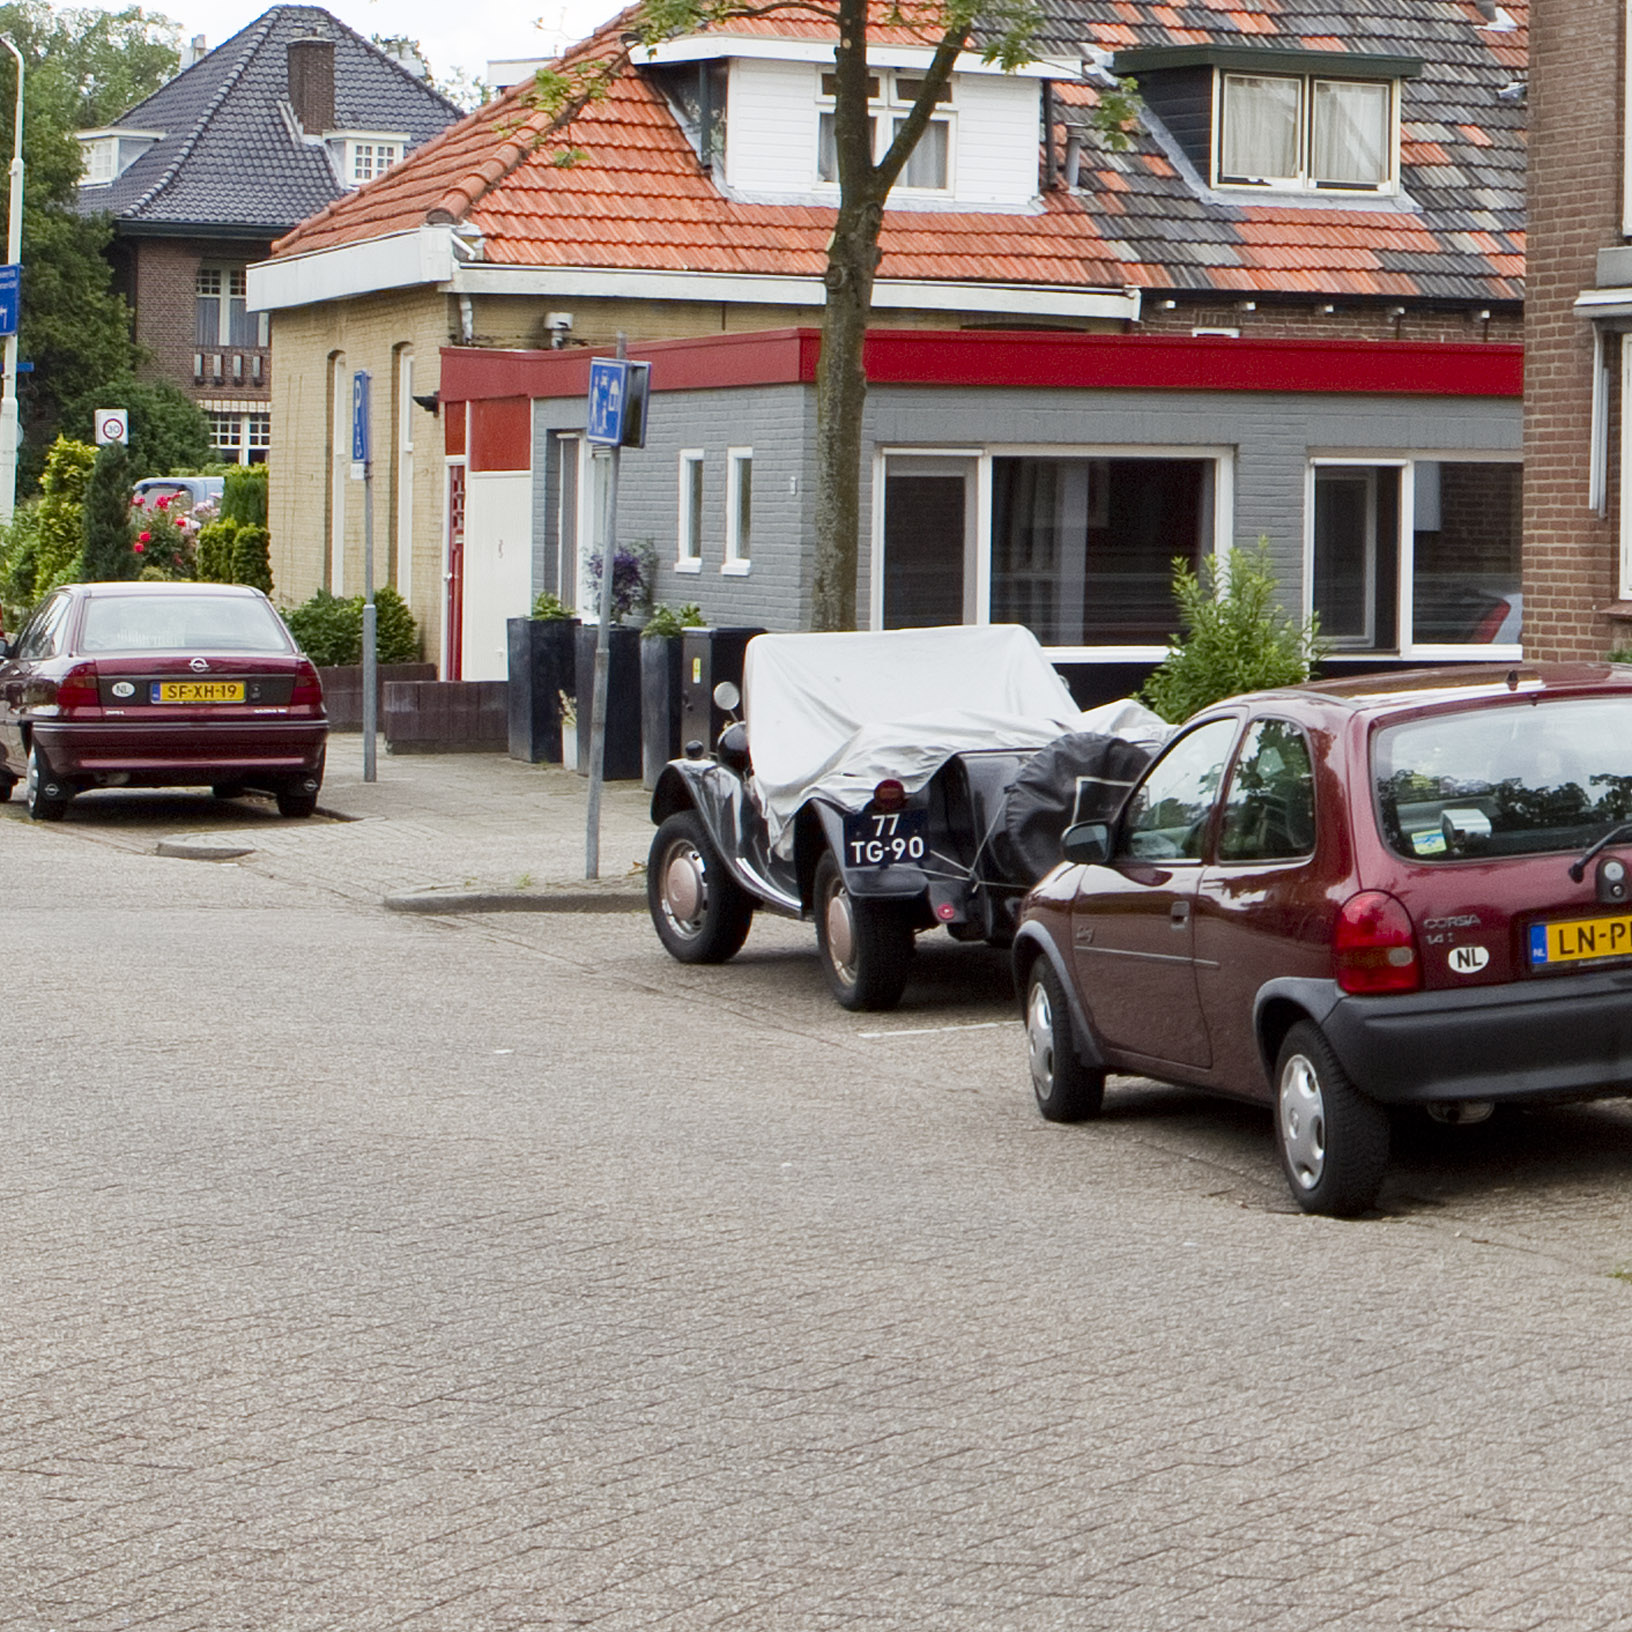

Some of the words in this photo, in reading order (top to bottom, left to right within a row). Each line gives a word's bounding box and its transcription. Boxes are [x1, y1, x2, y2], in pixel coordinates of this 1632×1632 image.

[106, 425, 120, 434] 30
[116, 684, 129, 694] NL
[167, 685, 237, 699] SF-XH-19
[871, 813, 900, 837] 77
[850, 836, 924, 864] TG-90
[1423, 914, 1481, 929] CORSA
[1457, 948, 1483, 968] NL
[1533, 948, 1546, 958] NL
